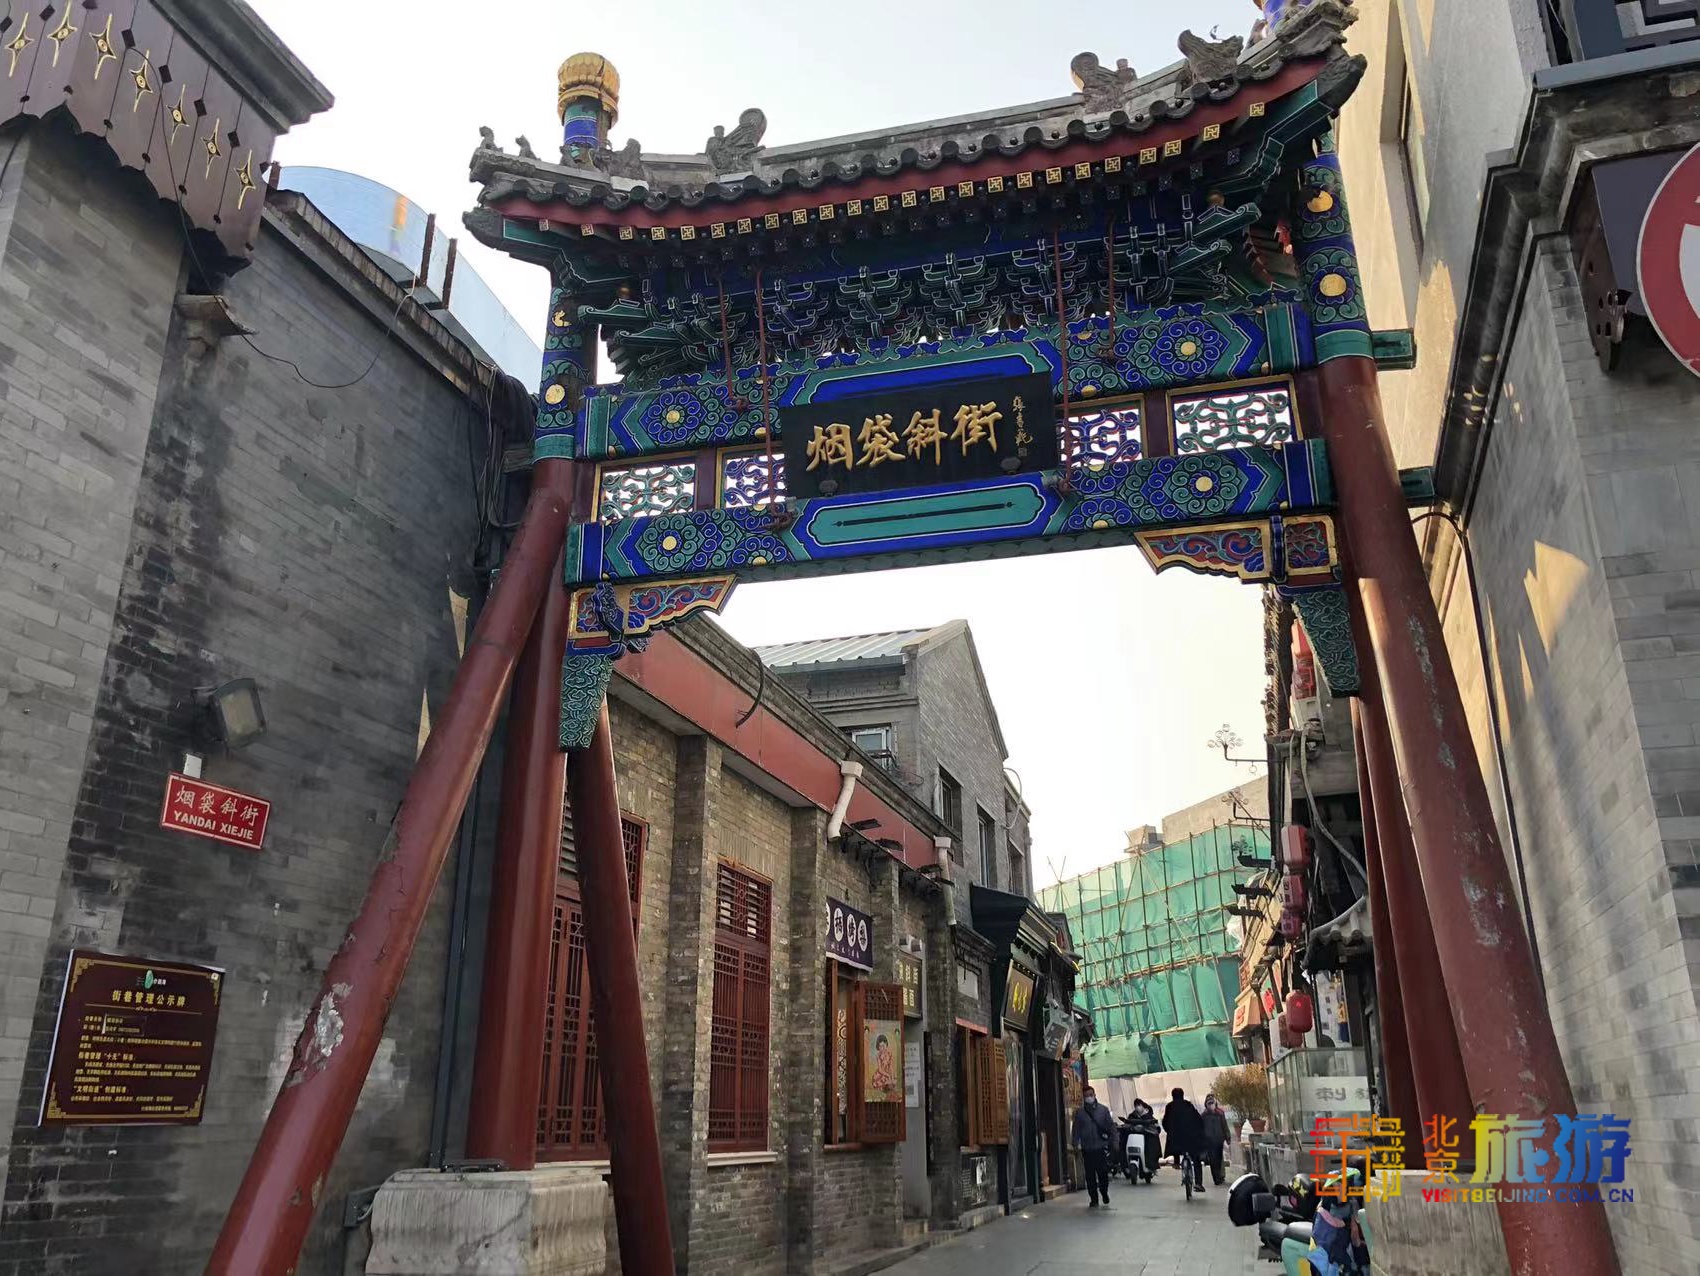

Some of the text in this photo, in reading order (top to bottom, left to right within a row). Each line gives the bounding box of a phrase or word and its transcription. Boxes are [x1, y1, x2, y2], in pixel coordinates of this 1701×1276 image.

[806, 401, 1003, 471] 烟袋斜街
[173, 810, 254, 840] YANDAI XIEJIE
[174, 785, 259, 827] 烟袋斜街
